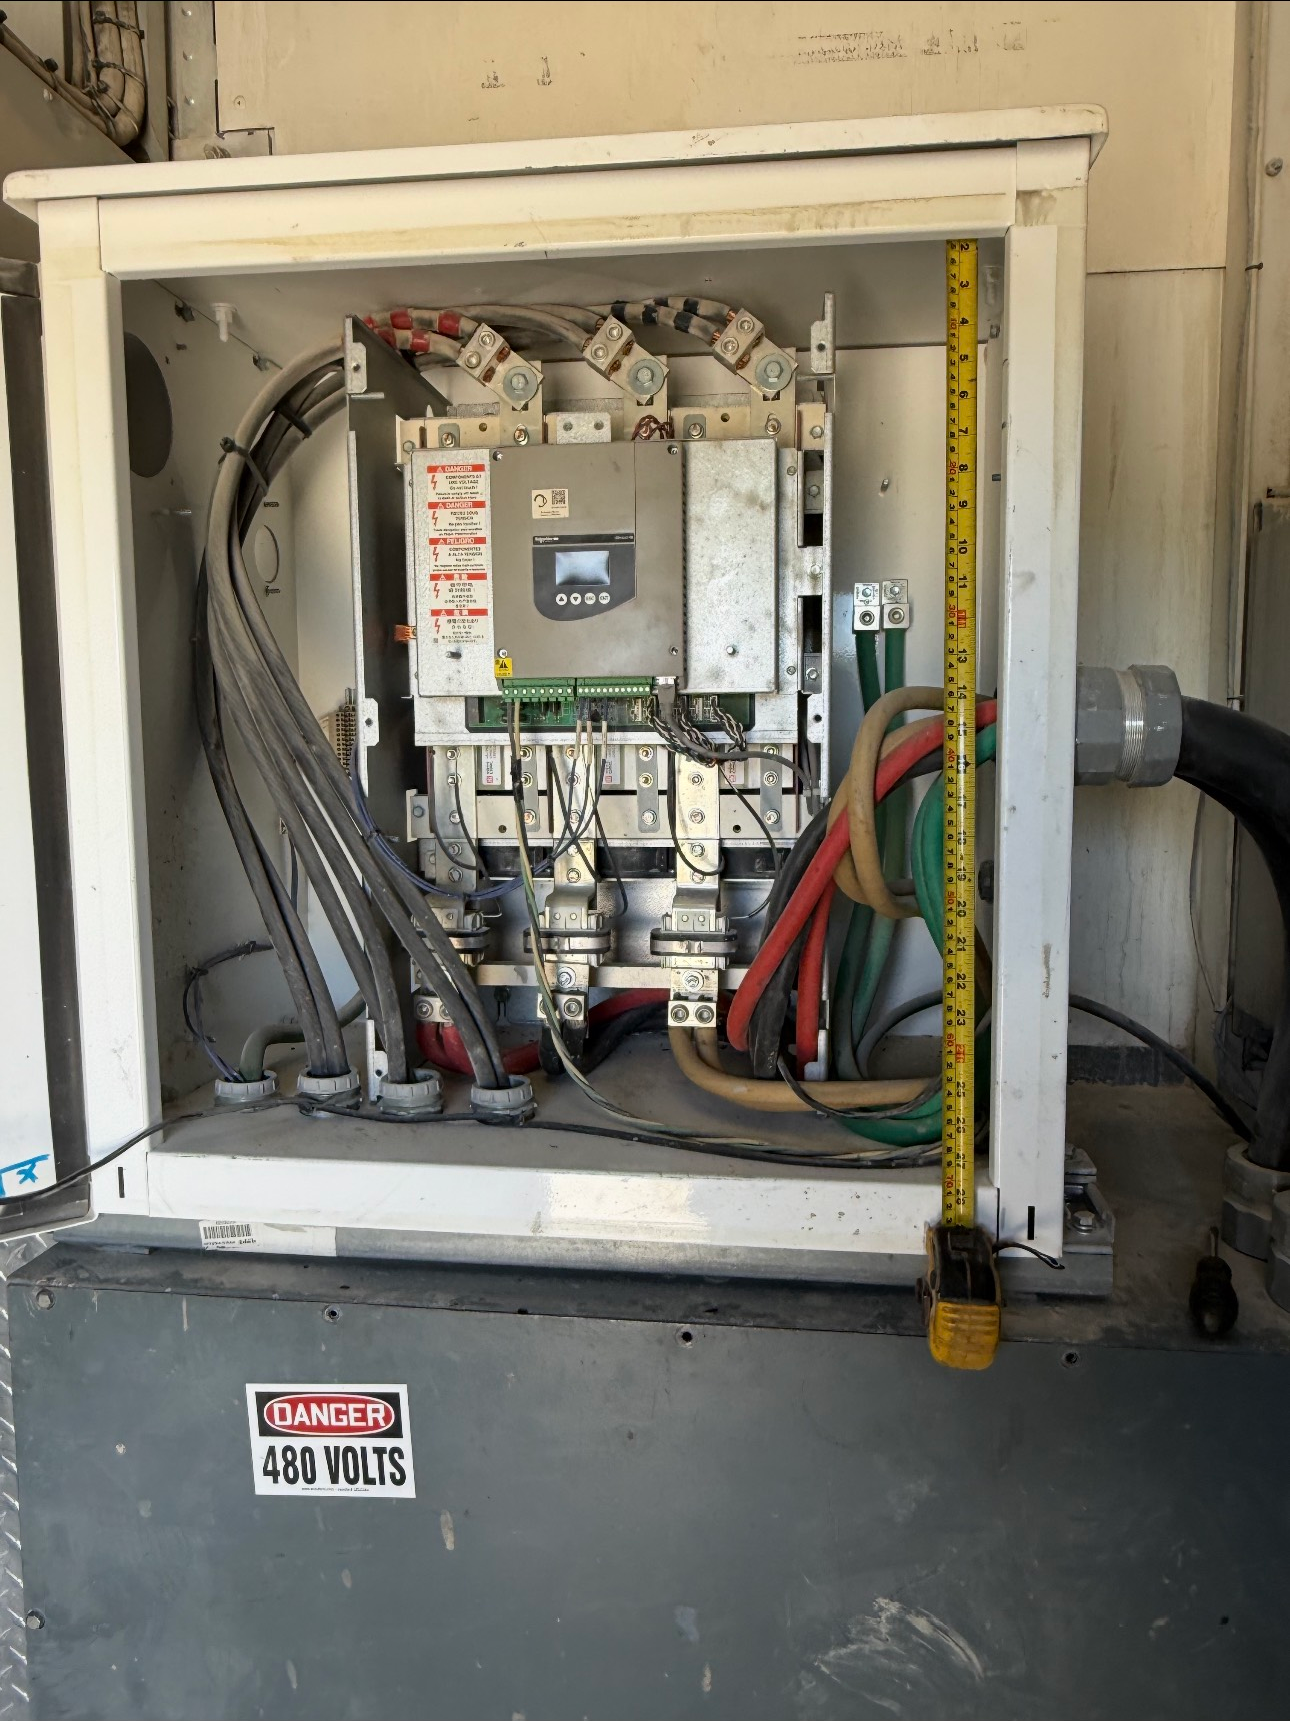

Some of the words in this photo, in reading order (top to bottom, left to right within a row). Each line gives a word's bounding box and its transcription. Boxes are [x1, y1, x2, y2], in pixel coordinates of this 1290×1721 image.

[961, 243, 969, 251] 2
[960, 354, 968, 362] 5
[959, 500, 967, 508] 9
[959, 539, 967, 554] 10
[959, 575, 967, 589] 11
[957, 649, 967, 664] 13
[958, 685, 967, 700] 14
[957, 867, 966, 881] 19
[957, 901, 966, 917] 20
[957, 937, 966, 952] 21
[957, 973, 966, 990] 22
[957, 1009, 965, 1026] 23
[957, 1082, 965, 1097] 25
[957, 1117, 965, 1134] 26
[272, 1402, 386, 1427] DANGER
[263, 1445, 317, 1485] 480
[324, 1446, 407, 1486] VOLTS
